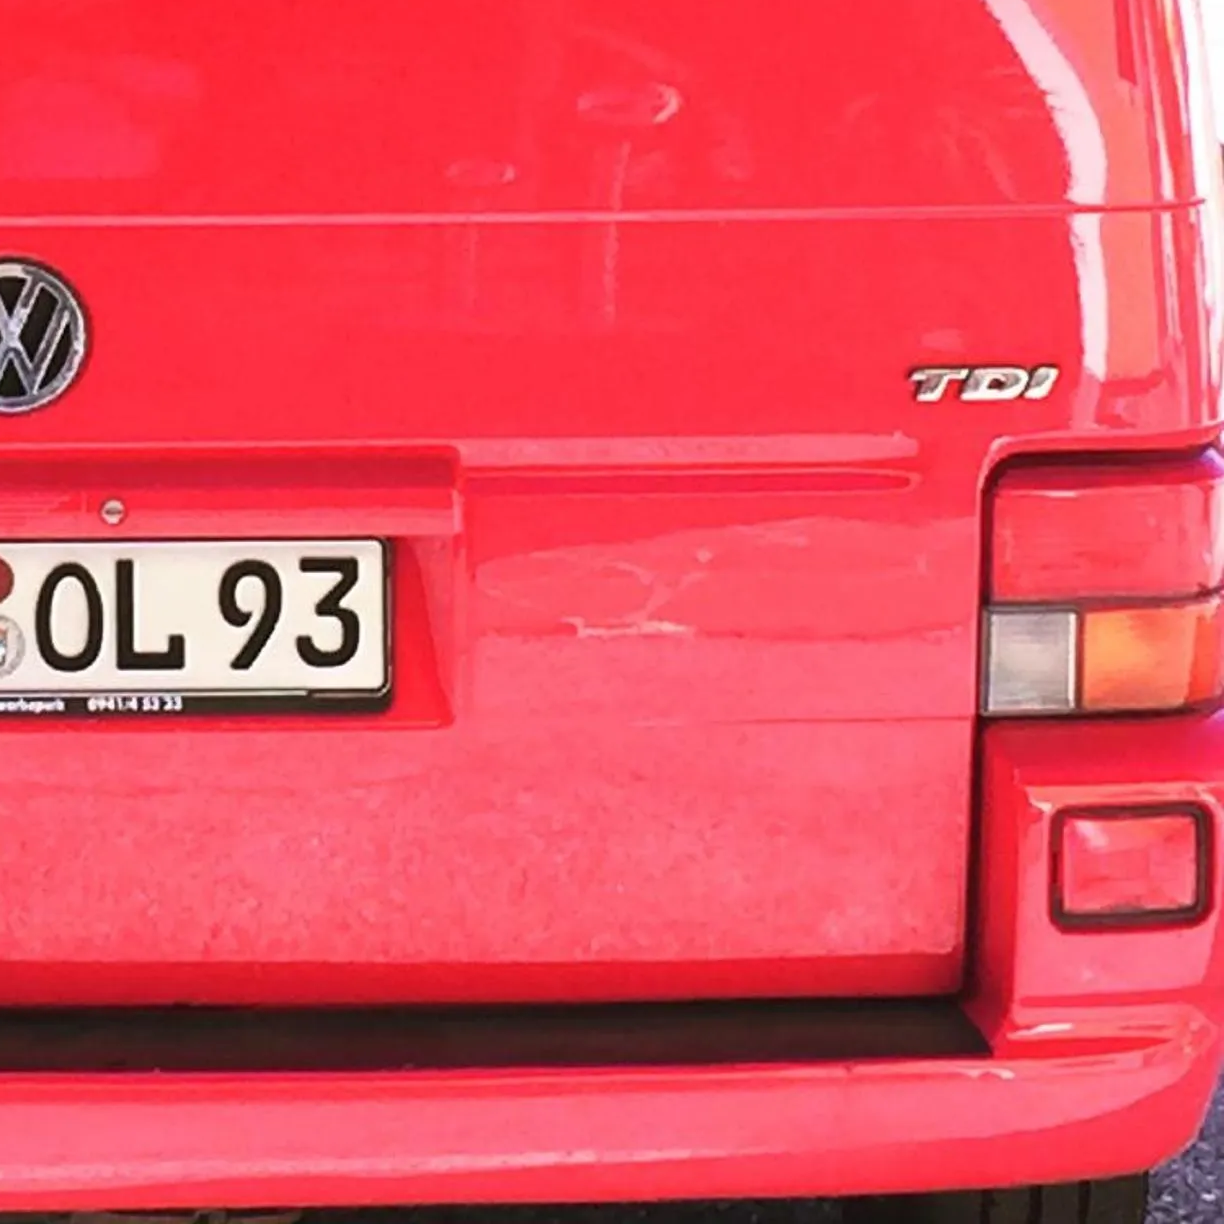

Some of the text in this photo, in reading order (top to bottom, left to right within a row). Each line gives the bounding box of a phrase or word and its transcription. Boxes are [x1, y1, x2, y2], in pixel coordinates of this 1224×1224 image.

[910, 365, 1060, 402] TDI
[34, 559, 185, 672] OL
[217, 557, 360, 670] 93
